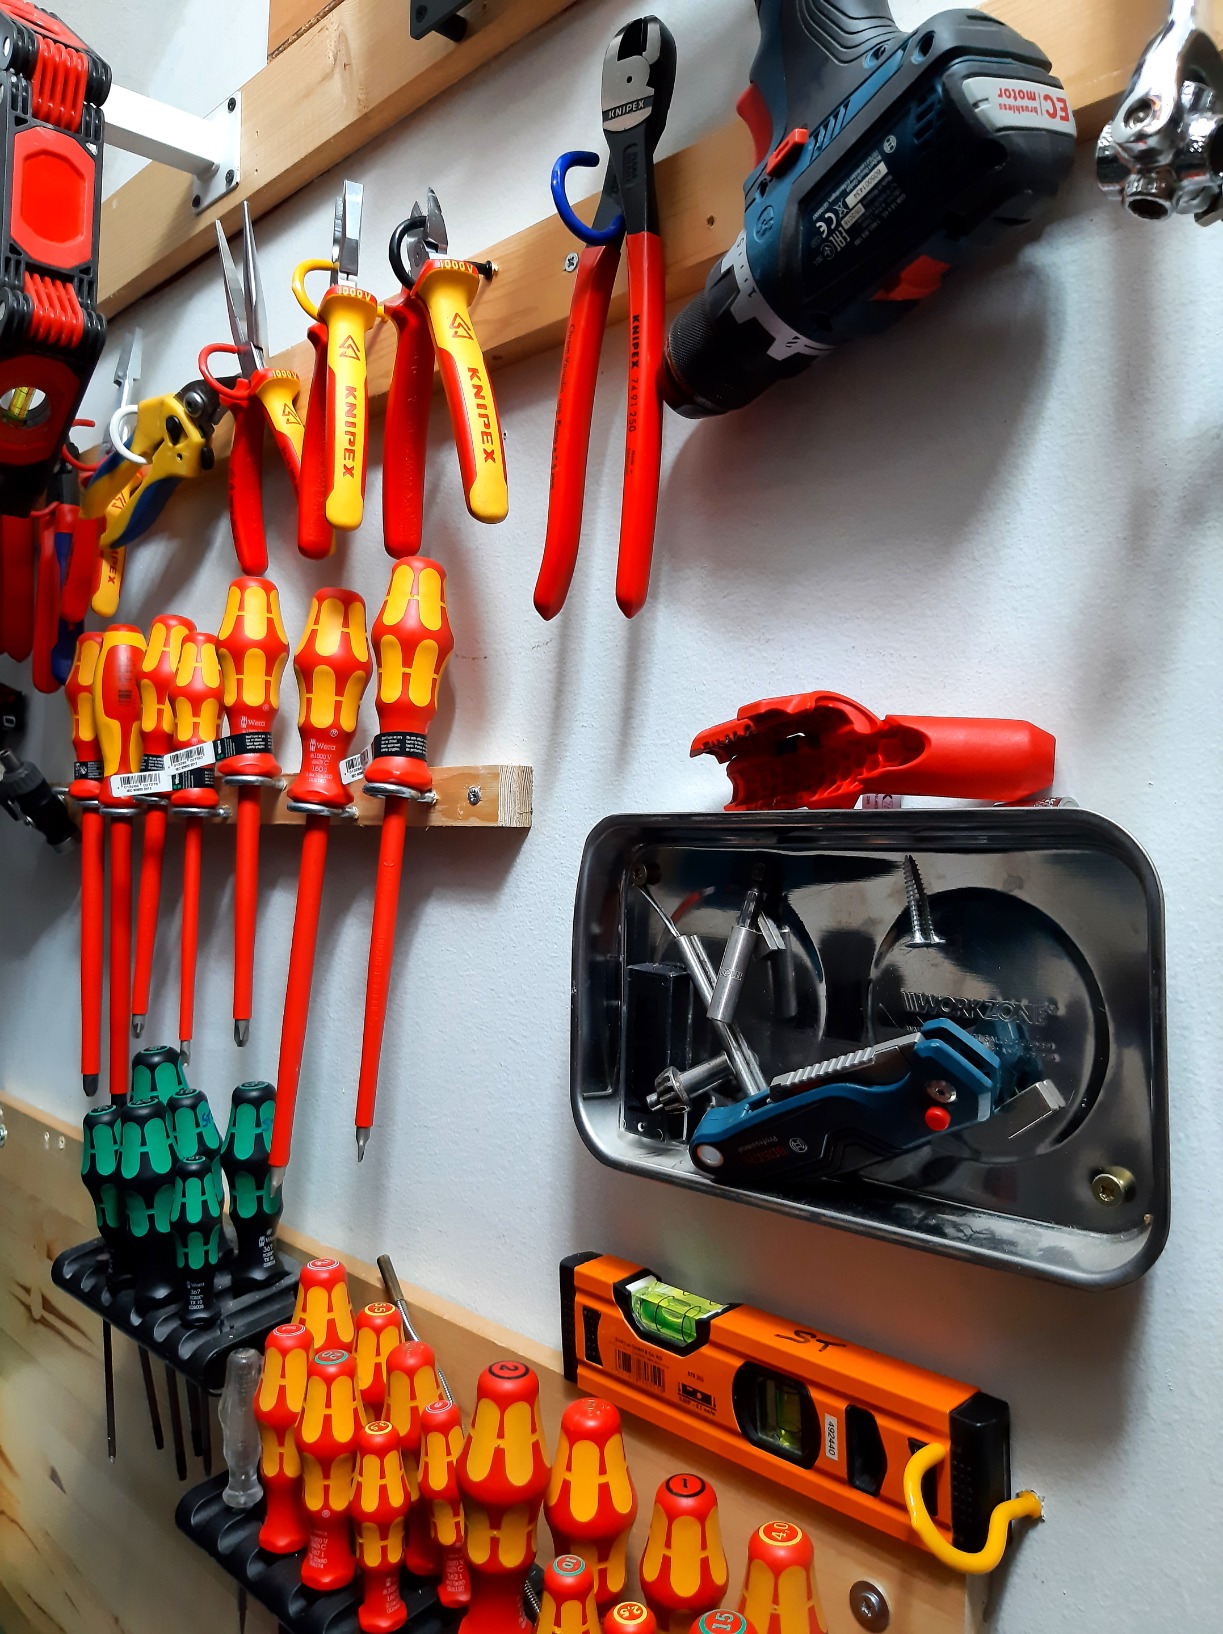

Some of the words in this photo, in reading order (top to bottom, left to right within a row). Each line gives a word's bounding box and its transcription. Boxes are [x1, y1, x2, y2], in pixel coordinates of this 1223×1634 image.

[997, 87, 1037, 102] motor
[608, 99, 645, 119] KNIPEX
[999, 103, 1039, 116] brushless
[1043, 93, 1070, 122] EC
[631, 314, 640, 369] KNIPEX
[467, 367, 496, 464] KNIPEX
[342, 386, 357, 478] KNIPEX
[108, 550, 119, 585] IPEX
[316, 742, 336, 751] Wera
[774, 1329, 847, 1352] ST
[499, 1364, 519, 1372] 2
[828, 1420, 836, 1456] 492440
[771, 1522, 791, 1541] 4,0
[562, 1557, 577, 1569] 10
[620, 1605, 641, 1618] 2,5
[711, 1612, 734, 1631] 15
